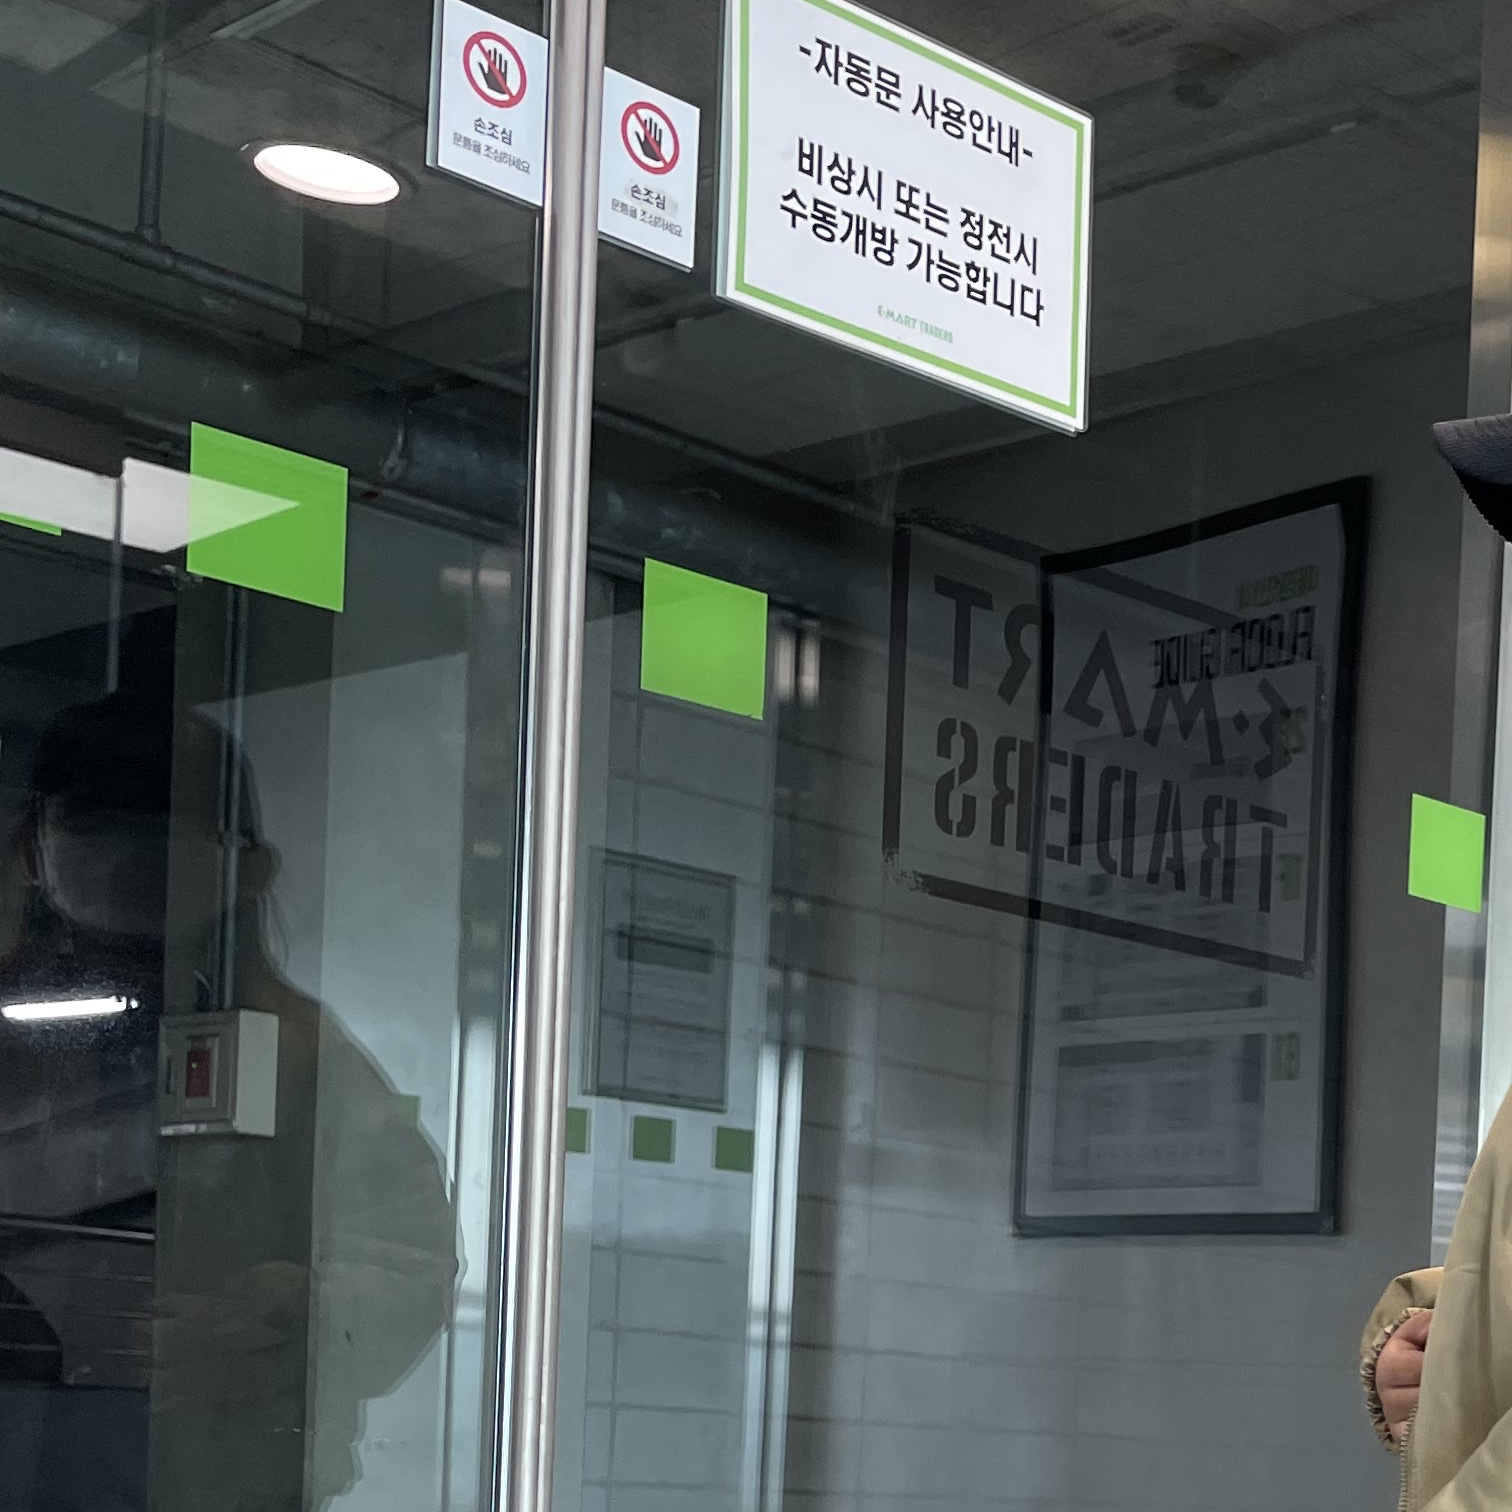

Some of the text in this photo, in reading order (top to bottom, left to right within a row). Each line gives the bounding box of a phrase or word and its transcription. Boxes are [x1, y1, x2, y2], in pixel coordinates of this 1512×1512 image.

[473, 116, 513, 146] 손조심
[799, 36, 1034, 168] -자동문 사용안내-
[630, 183, 666, 211] 손조심
[779, 187, 1045, 328] 수동개방 가능합니다
[797, 136, 1038, 276] 비상시 또는 정전시
